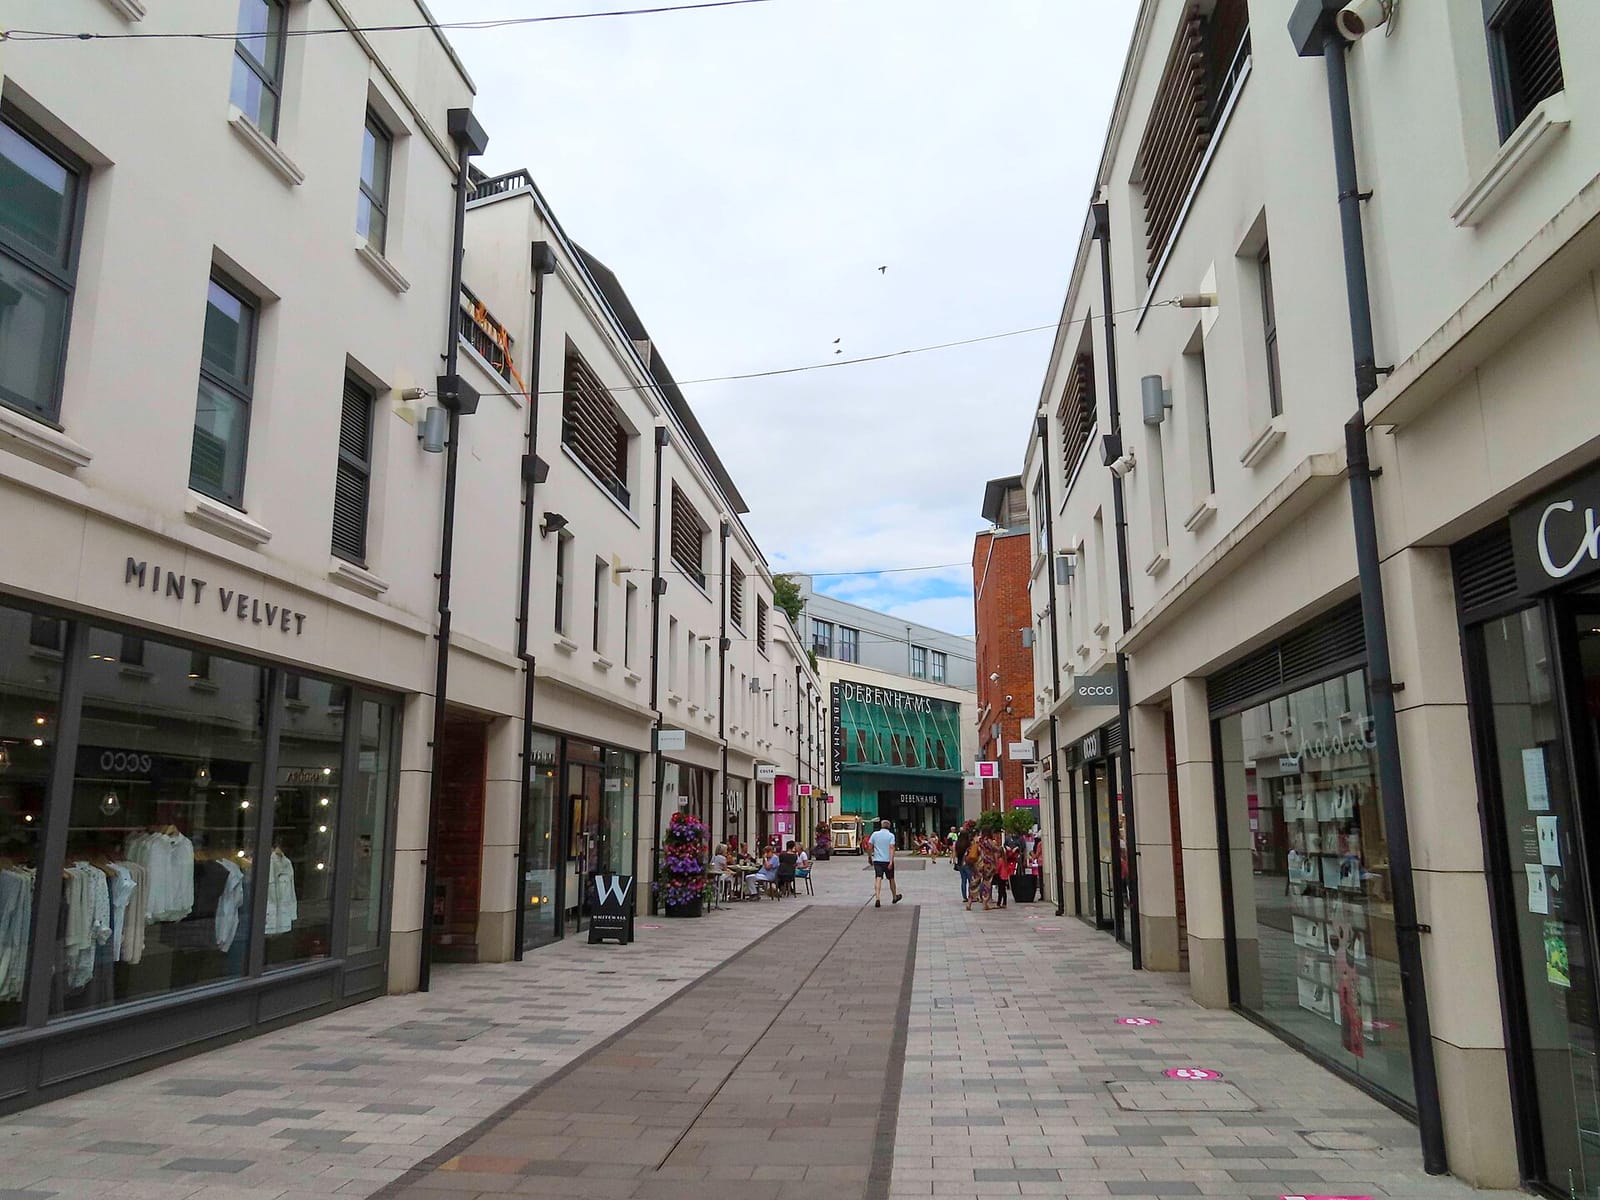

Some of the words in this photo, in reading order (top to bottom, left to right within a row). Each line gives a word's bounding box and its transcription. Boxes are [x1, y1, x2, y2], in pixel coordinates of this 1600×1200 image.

[125, 557, 207, 604] MINT
[219, 587, 307, 635] VELVET
[843, 683, 932, 714] DEBENHAMS
[1079, 686, 1113, 696] ecco
[900, 794, 937, 804] DEBENHAMS
[595, 875, 632, 906] W
